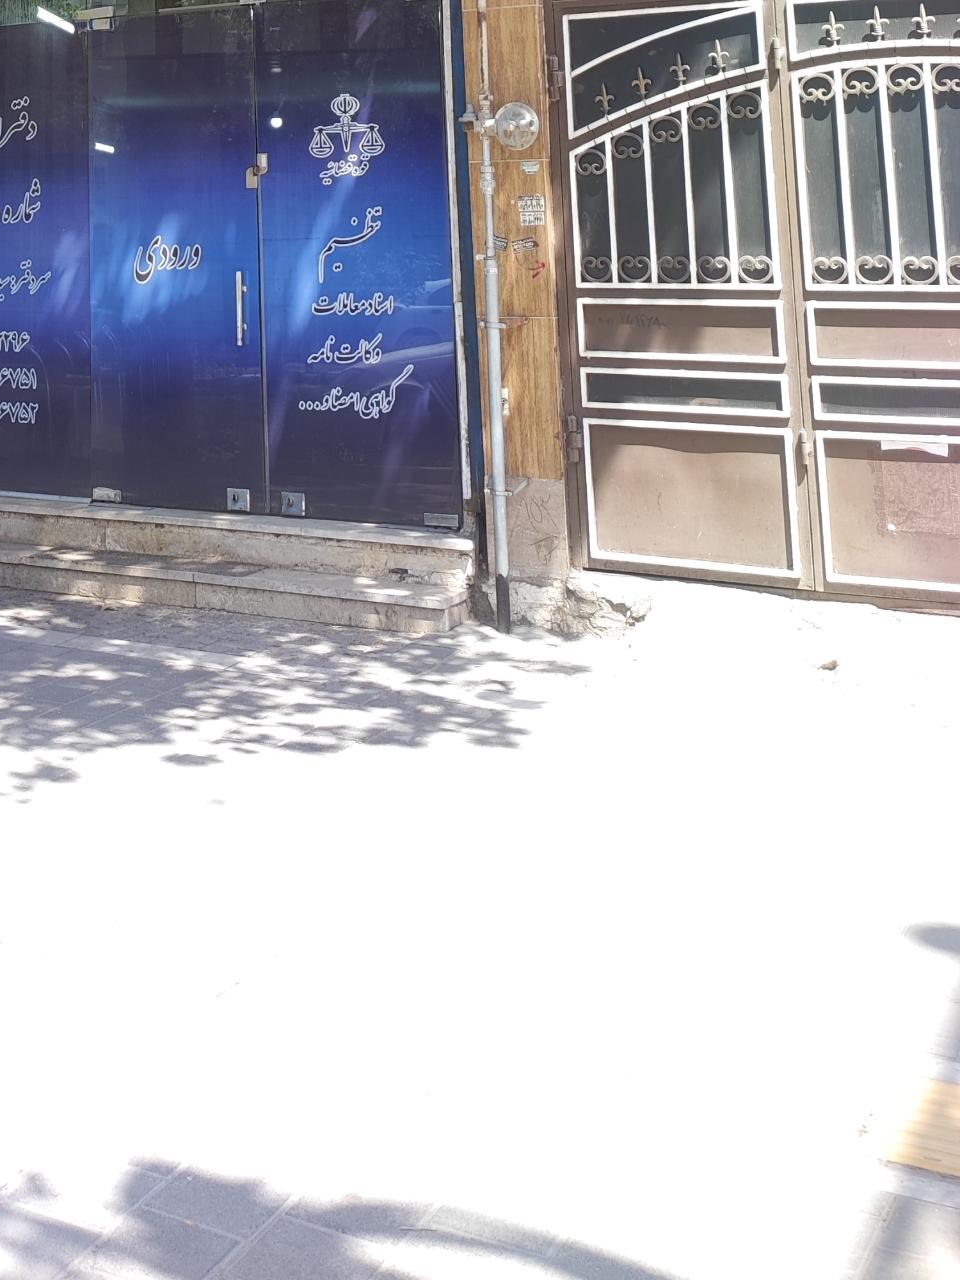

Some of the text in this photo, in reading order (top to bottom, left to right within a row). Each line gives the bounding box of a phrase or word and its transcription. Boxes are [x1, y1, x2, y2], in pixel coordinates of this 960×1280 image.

[351, 153, 371, 176] قوه
[2, 178, 41, 224] شماره
[133, 234, 202, 285] ورودی
[318, 206, 383, 284] تنظیم
[312, 292, 394, 316] اسناد معاملات
[307, 333, 382, 364] وکالت نامه
[359, 363, 415, 419] گواهی
